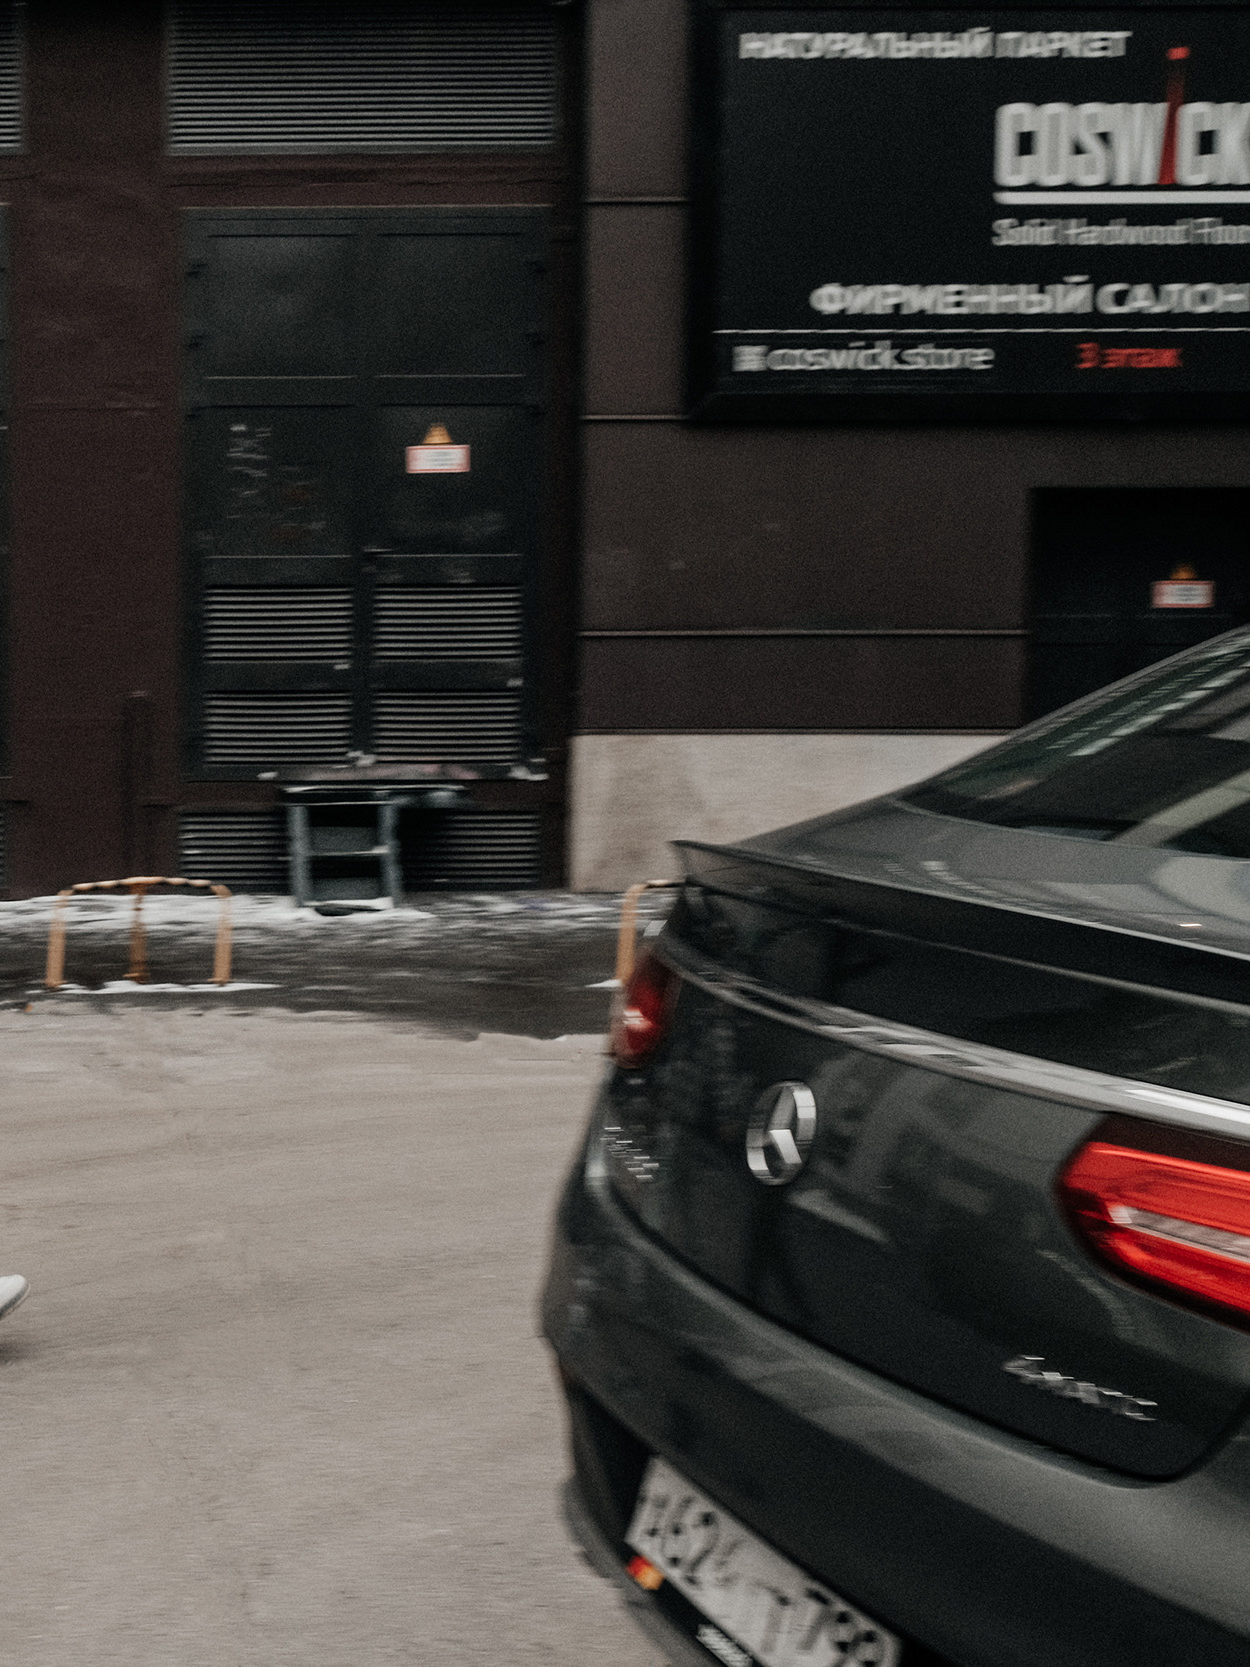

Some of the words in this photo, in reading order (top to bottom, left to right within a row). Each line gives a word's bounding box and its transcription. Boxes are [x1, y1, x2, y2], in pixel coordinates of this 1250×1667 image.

[739, 28, 993, 58] НАТУРАЛЬНЫЙ
[995, 31, 1133, 58] ПАРКЕТ
[809, 275, 1092, 315] ФИРМЕННЫЙ
[1094, 283, 1250, 316] САЛОН
